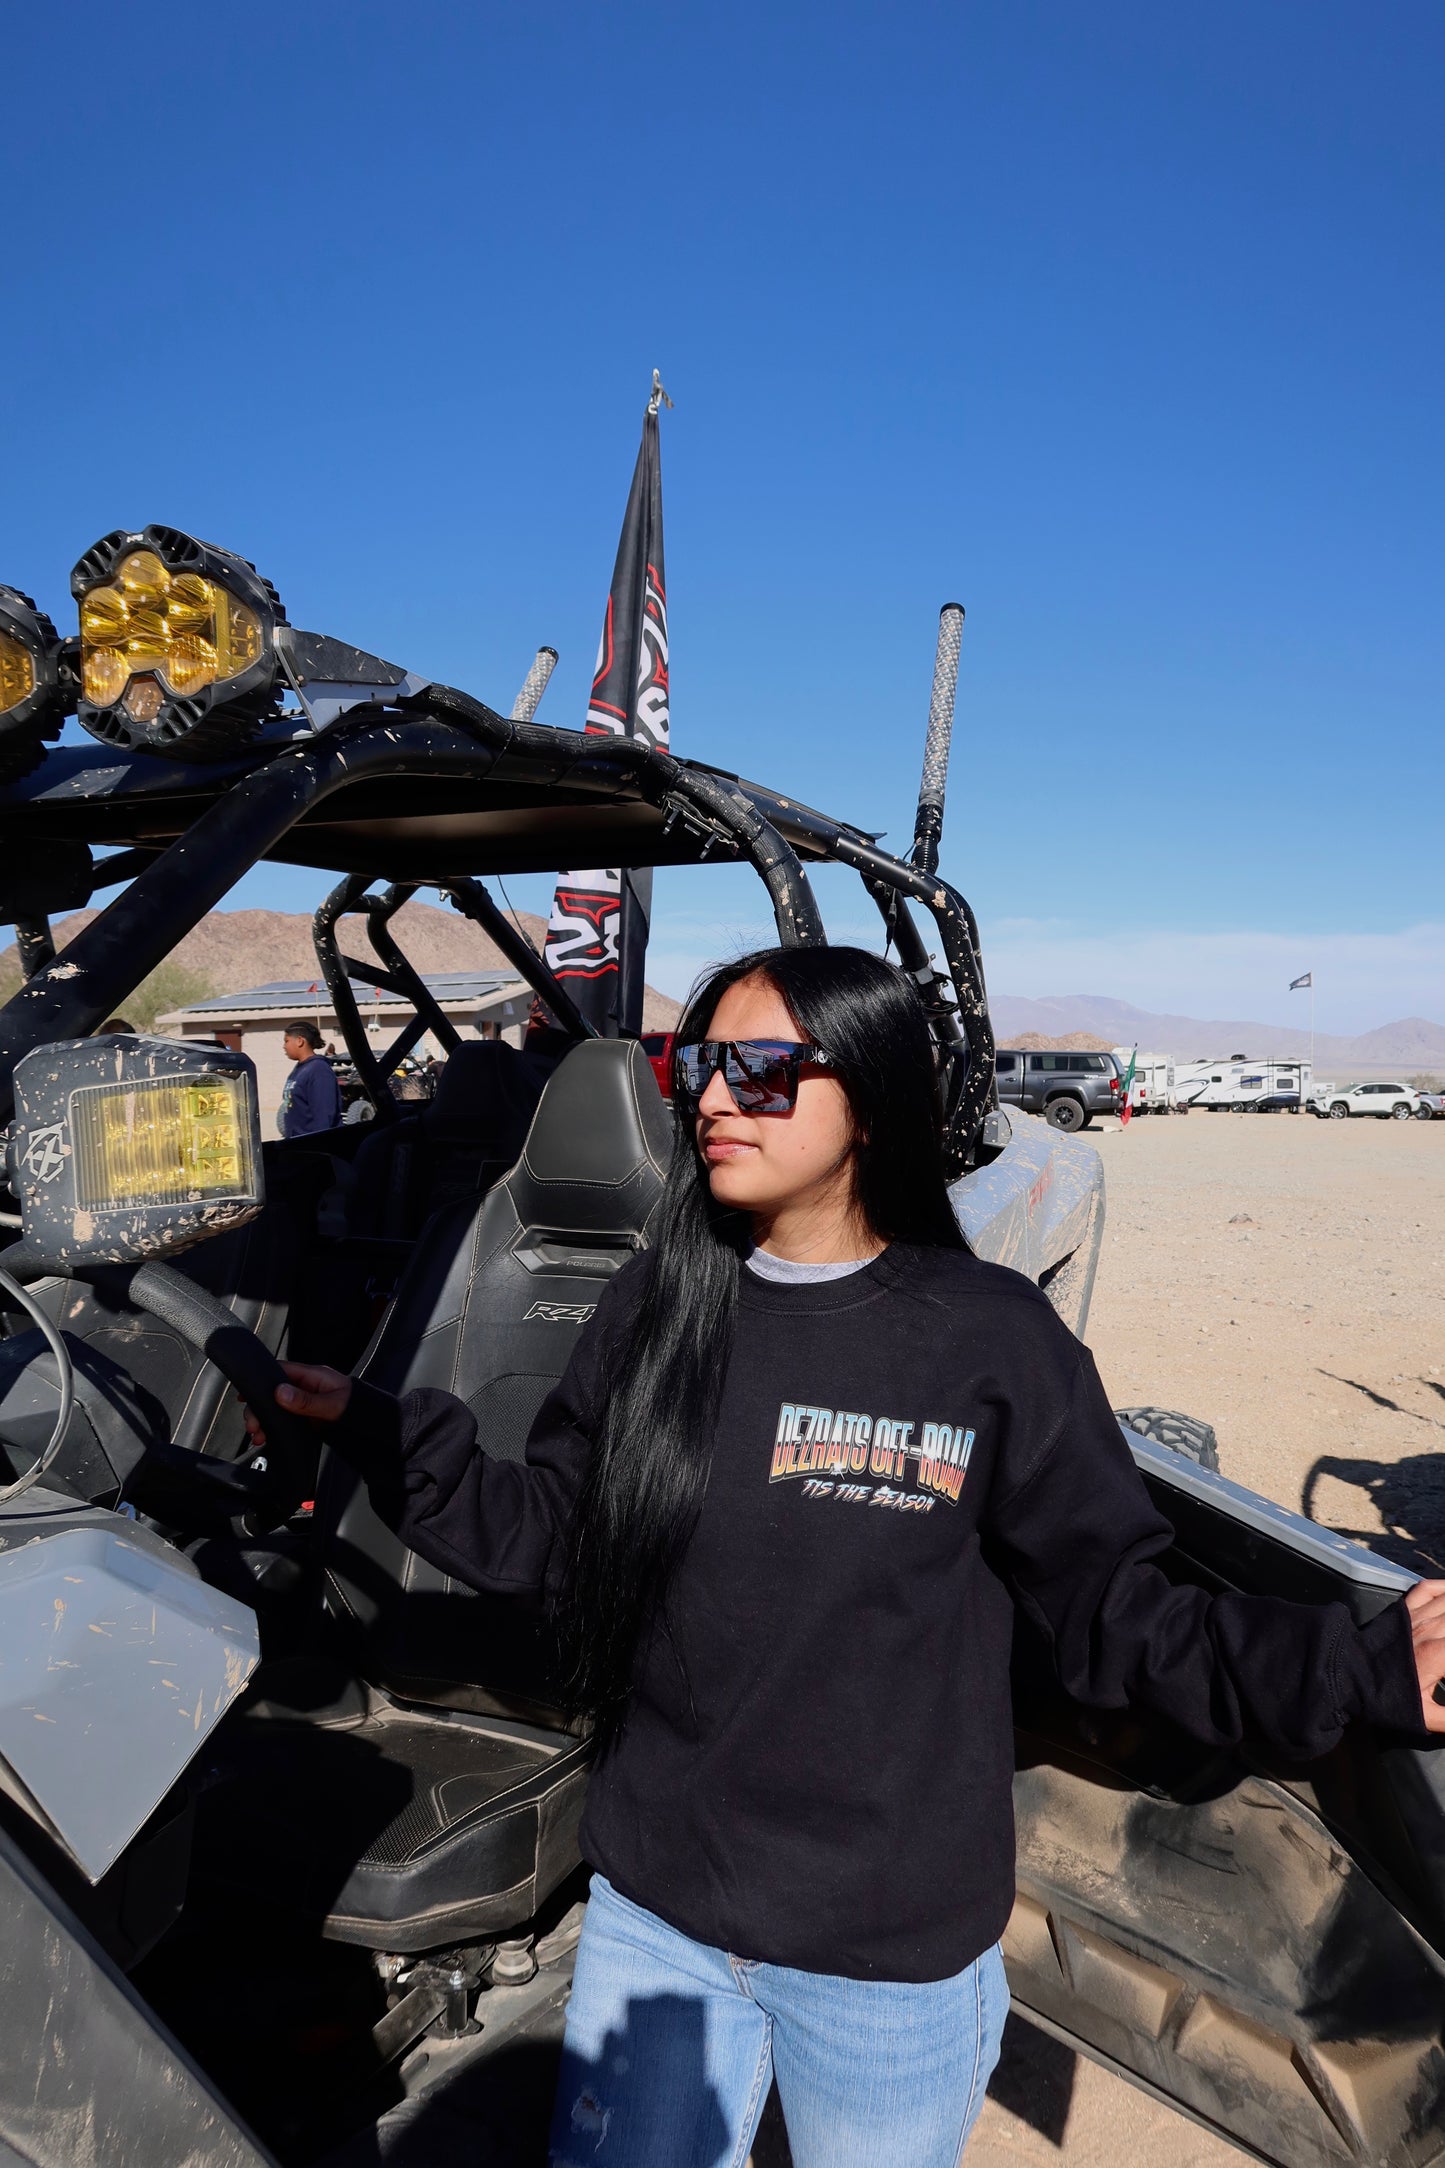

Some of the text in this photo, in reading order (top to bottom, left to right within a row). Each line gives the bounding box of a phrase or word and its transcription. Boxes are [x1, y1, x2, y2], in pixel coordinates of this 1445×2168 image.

[769, 1402, 976, 1507] DEZRATS OFF-ROAD
[833, 1483, 873, 1502] THE
[868, 1485, 937, 1514] SEASON
